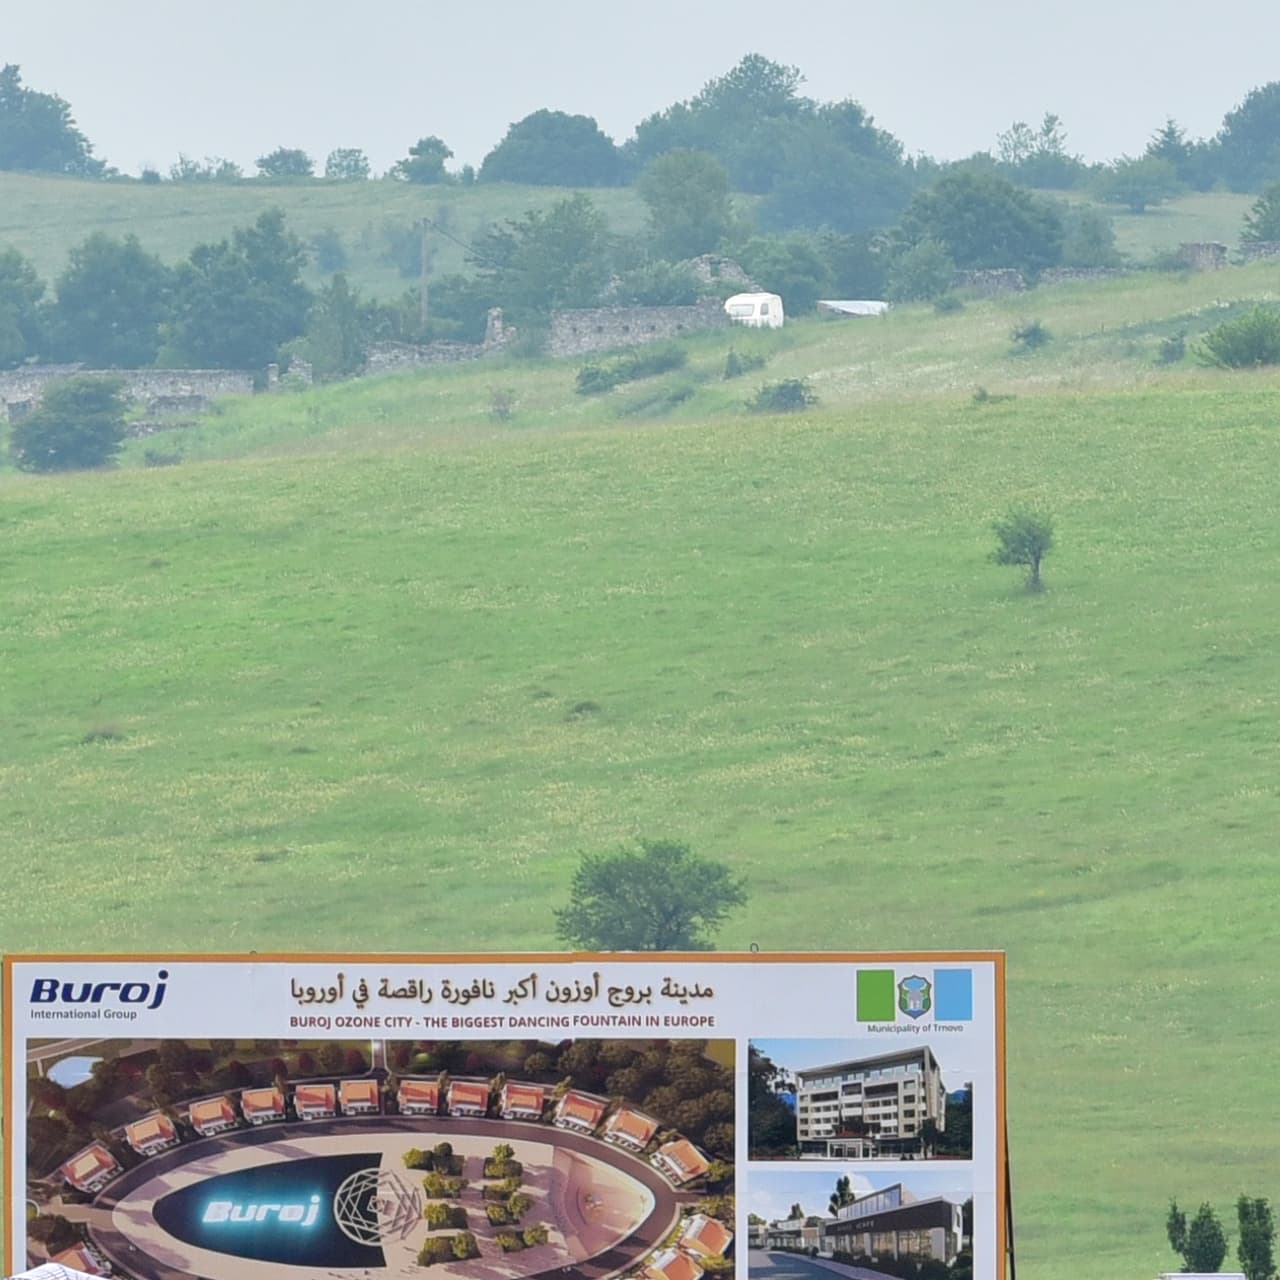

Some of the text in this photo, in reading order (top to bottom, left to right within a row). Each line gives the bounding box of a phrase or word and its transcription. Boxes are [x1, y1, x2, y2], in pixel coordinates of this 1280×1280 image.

[30, 970, 169, 1010] Buroj
[290, 971, 715, 1009] مدينة بروج أوزون أكبر نافورة راقصة في أوروبا
[30, 1009, 137, 1021] International Group
[290, 1016, 332, 1030] BUROJ
[335, 1016, 381, 1029] OZONE
[384, 1016, 413, 1028] CITY
[423, 1016, 449, 1028] THE
[451, 1016, 505, 1028] BIGGEST
[509, 1016, 570, 1028] DANCING
[573, 1015, 642, 1027] FOUNTAIN
[645, 1015, 660, 1027] IN
[663, 1015, 716, 1027] EUROPE
[867, 1024, 921, 1035] Municipality
[922, 1024, 932, 1032] of
[202, 1194, 320, 1226] Buroj
